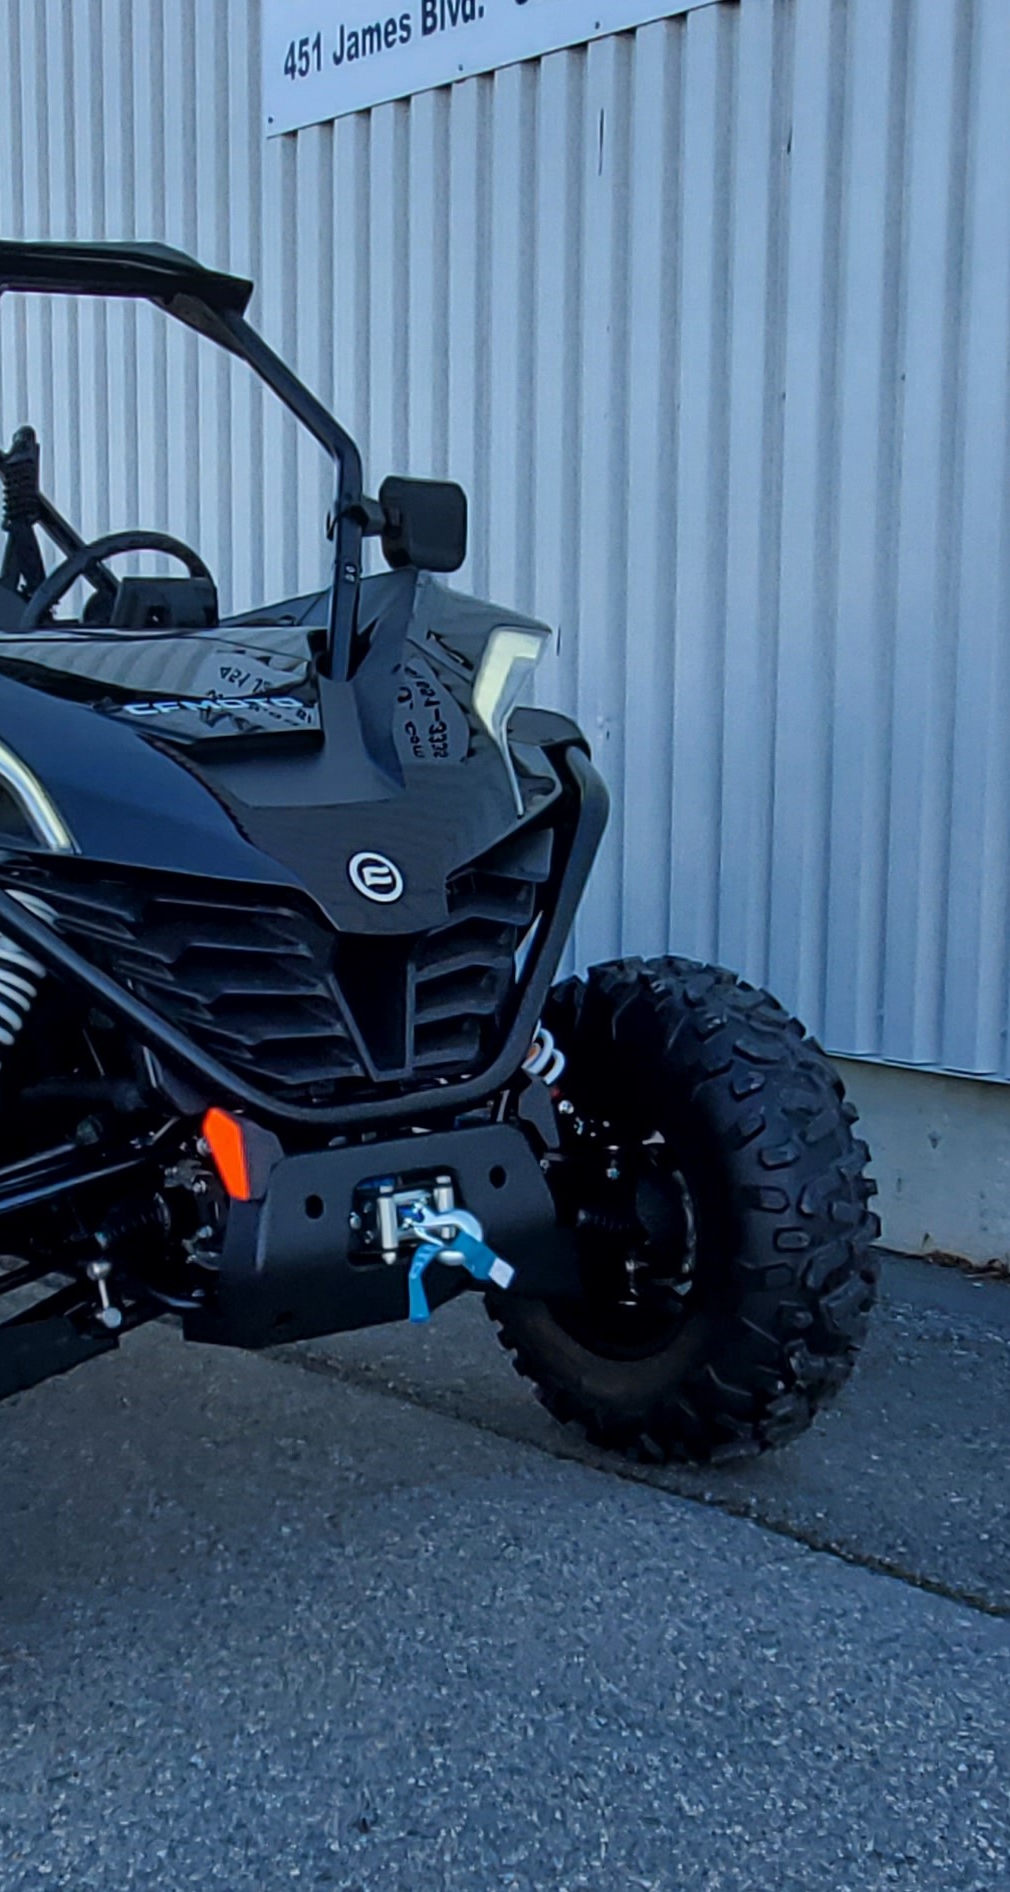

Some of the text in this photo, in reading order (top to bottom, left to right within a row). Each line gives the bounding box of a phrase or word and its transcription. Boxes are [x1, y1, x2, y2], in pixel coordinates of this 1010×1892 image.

[284, 32, 322, 80] 451
[332, 13, 411, 66] James
[123, 697, 303, 715] CFMOTO
